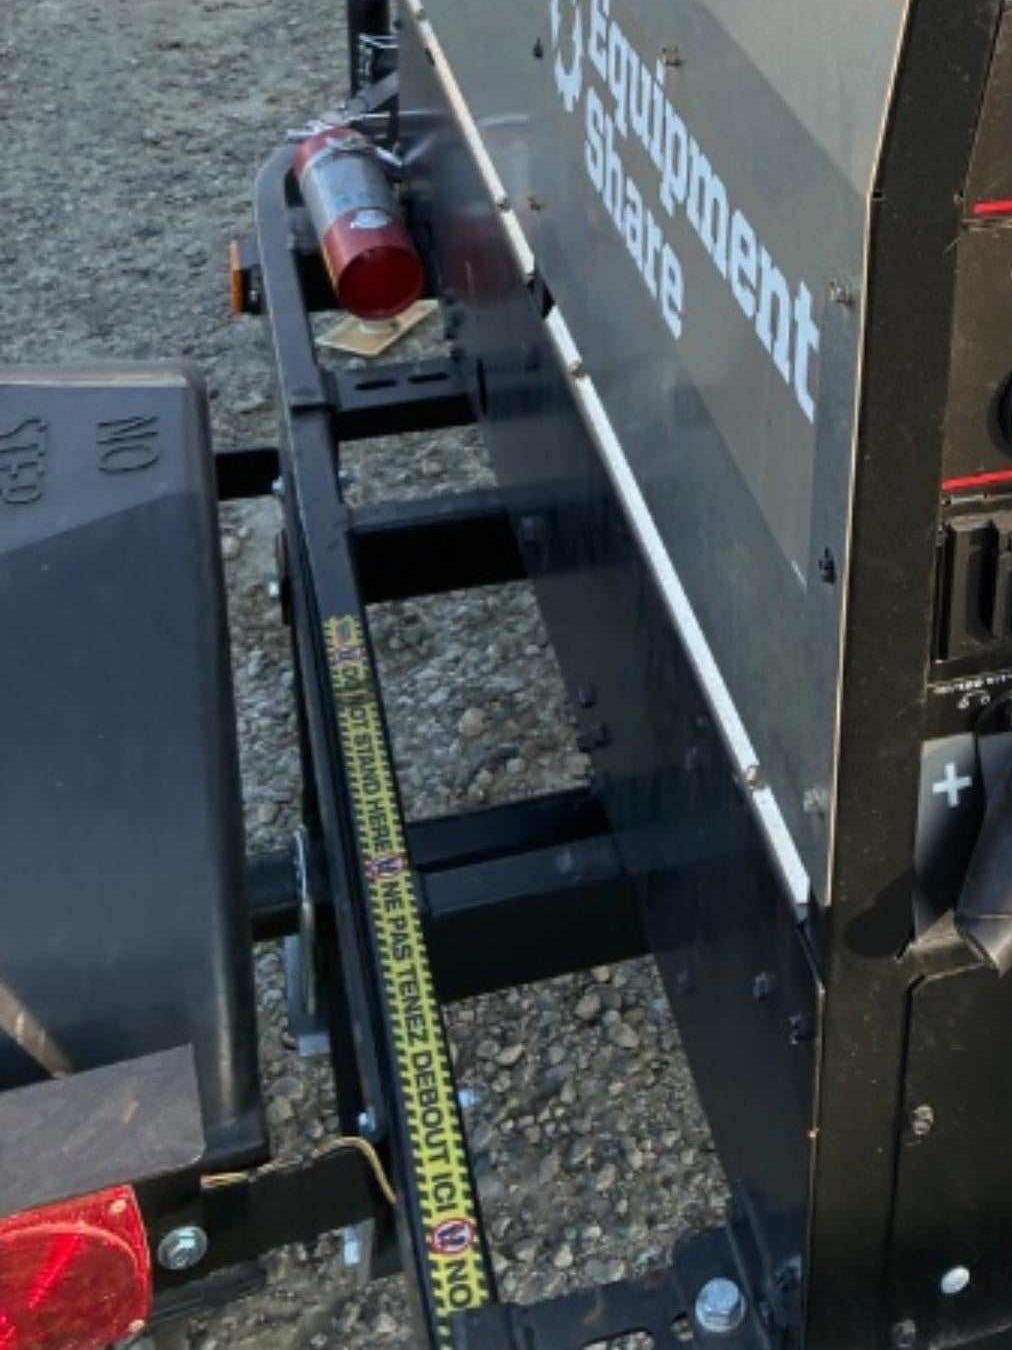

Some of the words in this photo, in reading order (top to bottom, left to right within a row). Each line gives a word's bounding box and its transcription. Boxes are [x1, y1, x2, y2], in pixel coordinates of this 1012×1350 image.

[584, 86, 686, 340] Share
[96, 415, 161, 475] NO
[353, 733, 382, 796] STAND
[366, 800, 392, 851] HERE
[381, 881, 401, 913] NE
[388, 915, 412, 963] PAS
[397, 963, 427, 1046] TENEZ
[411, 1052, 451, 1165] DEBOUT
[431, 1170, 458, 1213] ICI
[446, 1259, 473, 1309] NO
